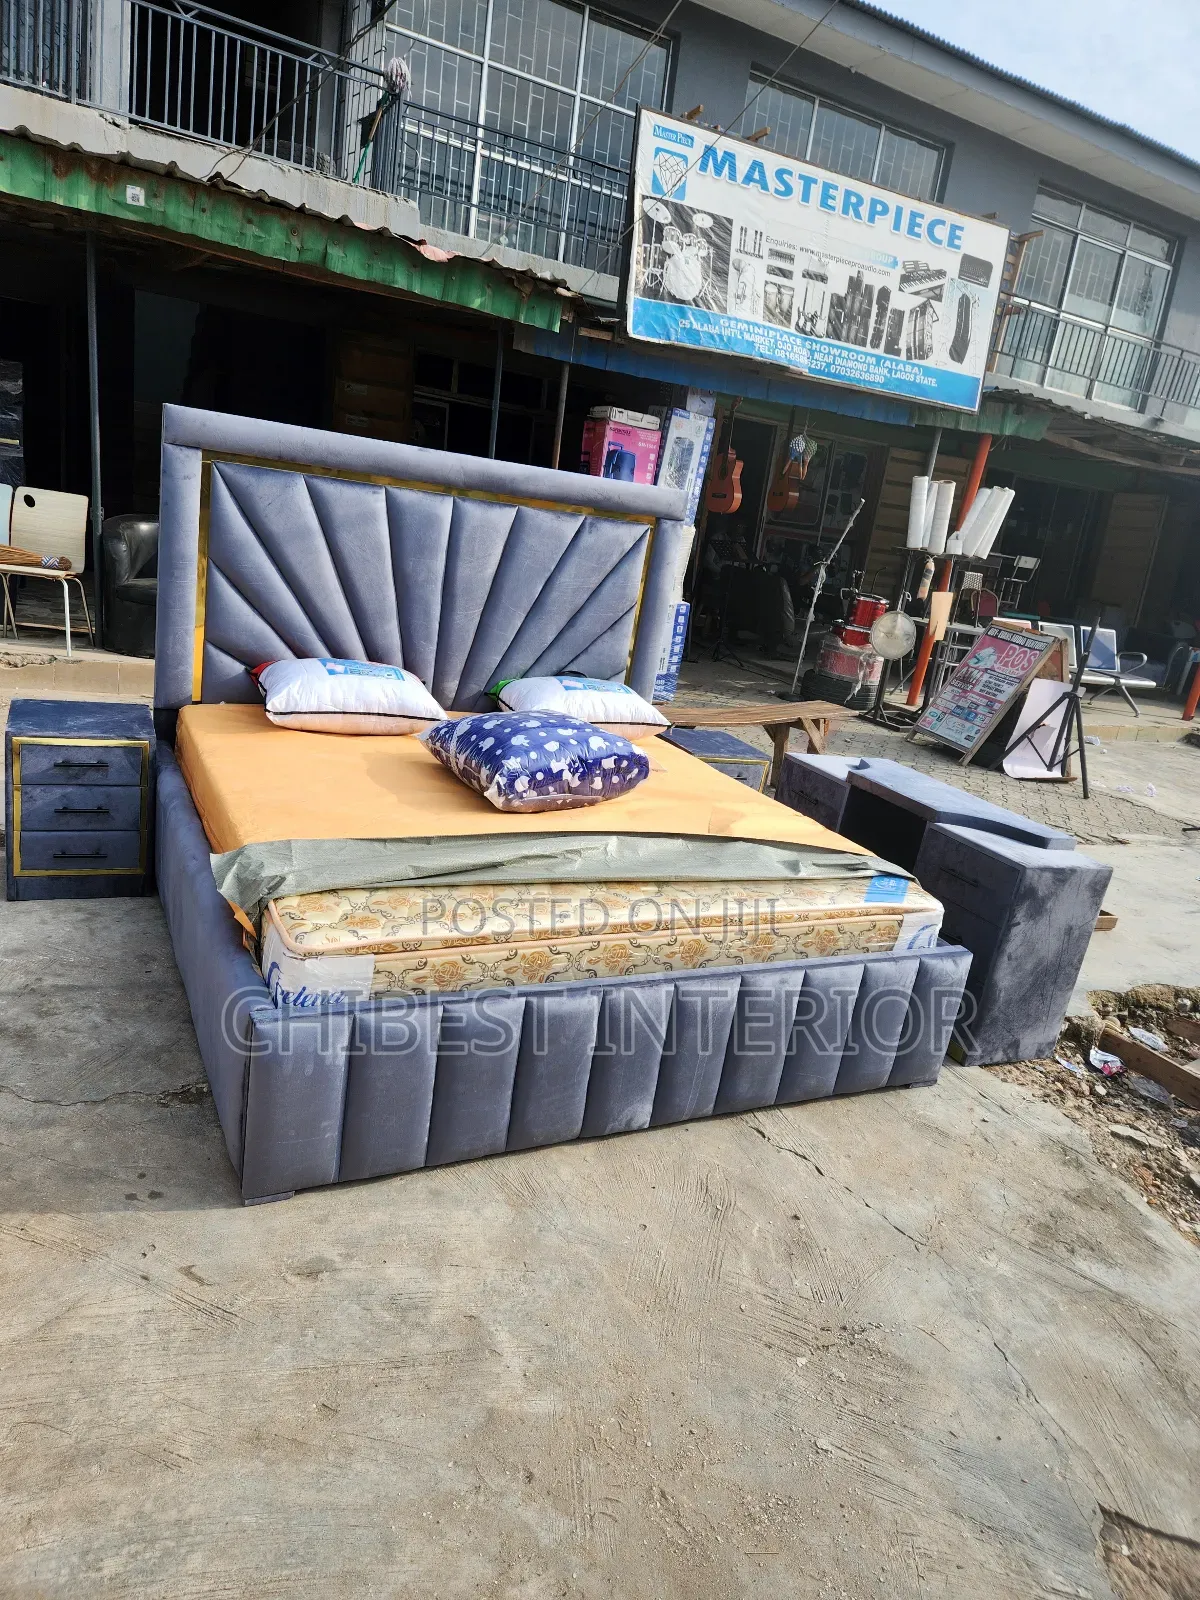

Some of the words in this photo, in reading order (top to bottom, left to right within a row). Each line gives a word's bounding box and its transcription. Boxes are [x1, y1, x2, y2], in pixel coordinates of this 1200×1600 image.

[654, 125, 677, 142] MASTER
[697, 144, 966, 251] MASTERPIECE
[766, 235, 797, 251] Enquiries:
[692, 320, 720, 334] ALABA
[743, 332, 776, 349] MARKET,
[777, 341, 791, 350] OJO
[813, 351, 835, 364] NEAR
[835, 357, 868, 371] DIAMOND
[869, 365, 890, 377] BANK,
[891, 371, 915, 381] LAGOS
[915, 376, 938, 387] STATE.
[720, 319, 802, 346] GEMINIPLACE
[805, 341, 877, 365] SHOWROOM
[880, 359, 923, 375] (ALABA)
[754, 342, 773, 356] TEL:
[830, 364, 885, 383] 07032636890
[997, 643, 1040, 672] POS
[953, 666, 983, 685] ATM
